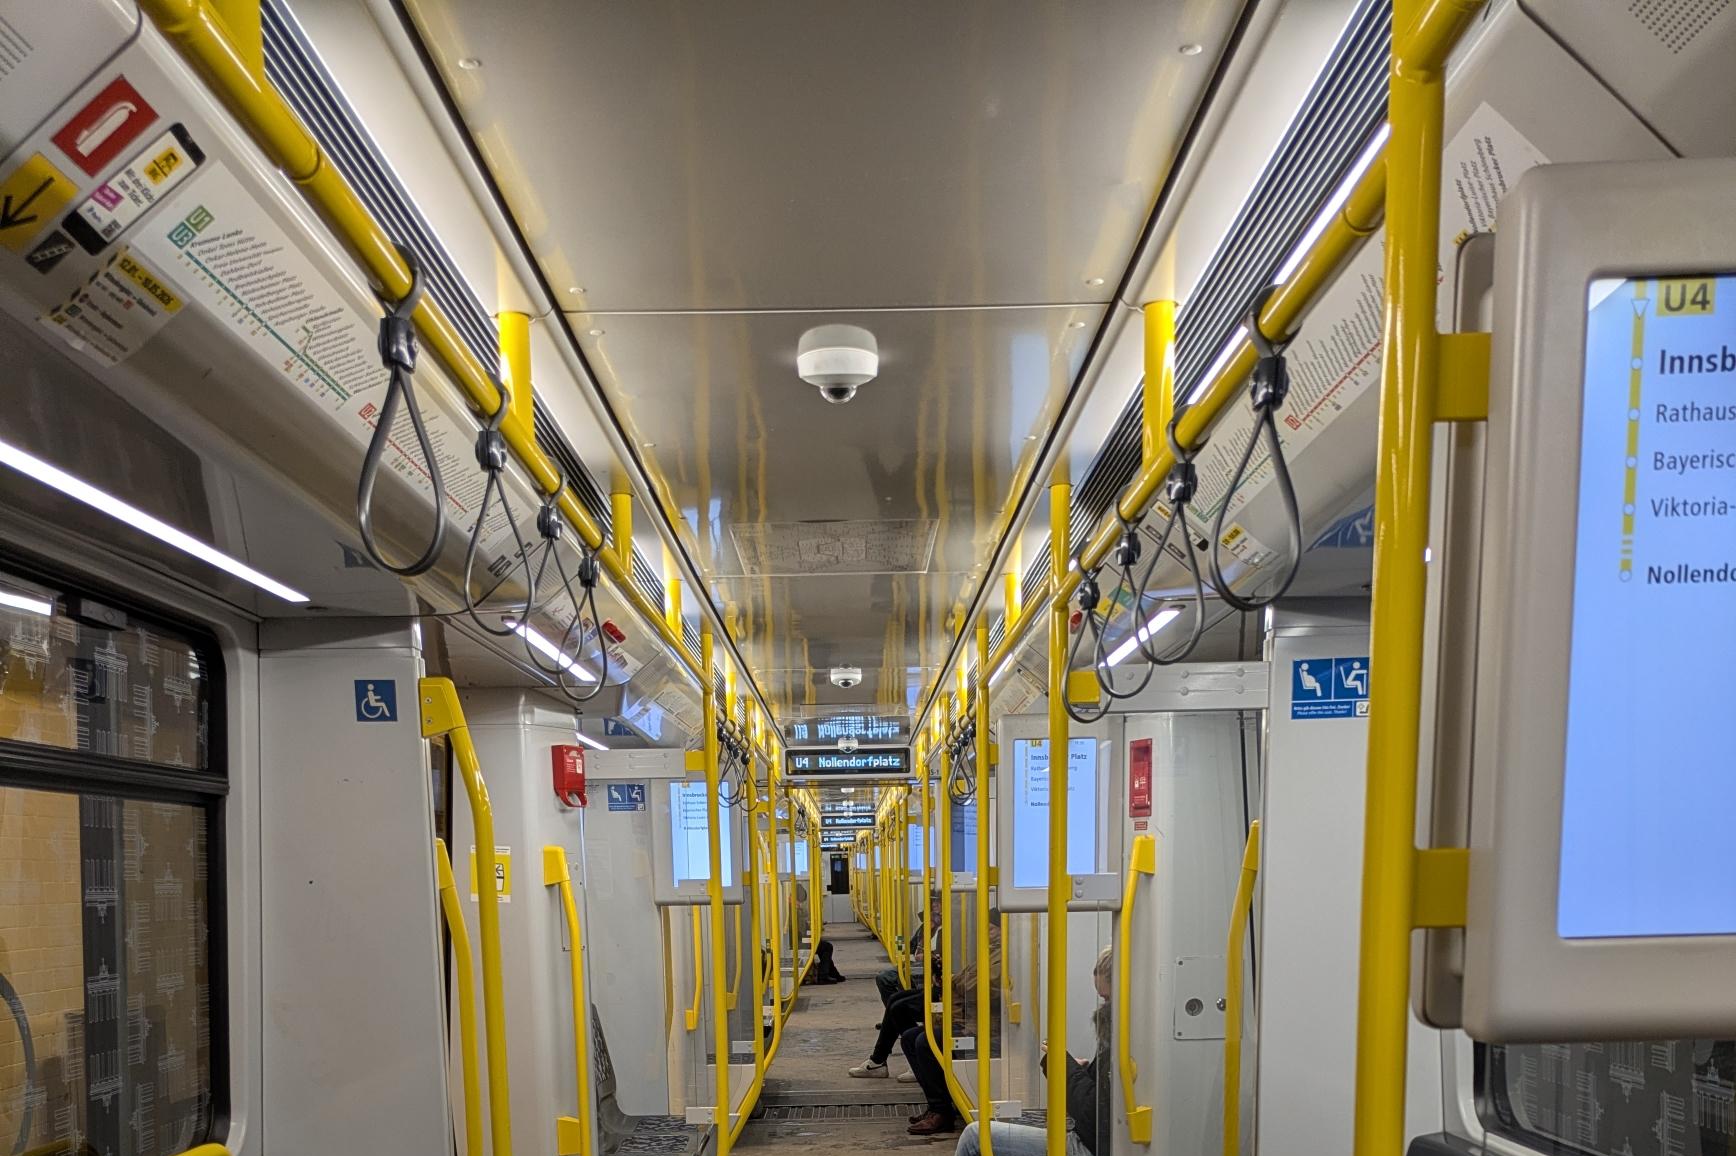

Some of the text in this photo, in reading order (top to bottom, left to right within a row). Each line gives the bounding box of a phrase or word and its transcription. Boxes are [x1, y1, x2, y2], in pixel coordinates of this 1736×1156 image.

[189, 208, 212, 231] U1
[171, 225, 194, 248] U3
[1664, 281, 1711, 313] U4
[1659, 345, 1736, 375] Innsb
[1656, 401, 1736, 424] Rathaus
[1653, 449, 1736, 475] Bayerisc
[1650, 496, 1736, 518] Viktoria-
[795, 755, 901, 768] U4 Nollendorfplatz
